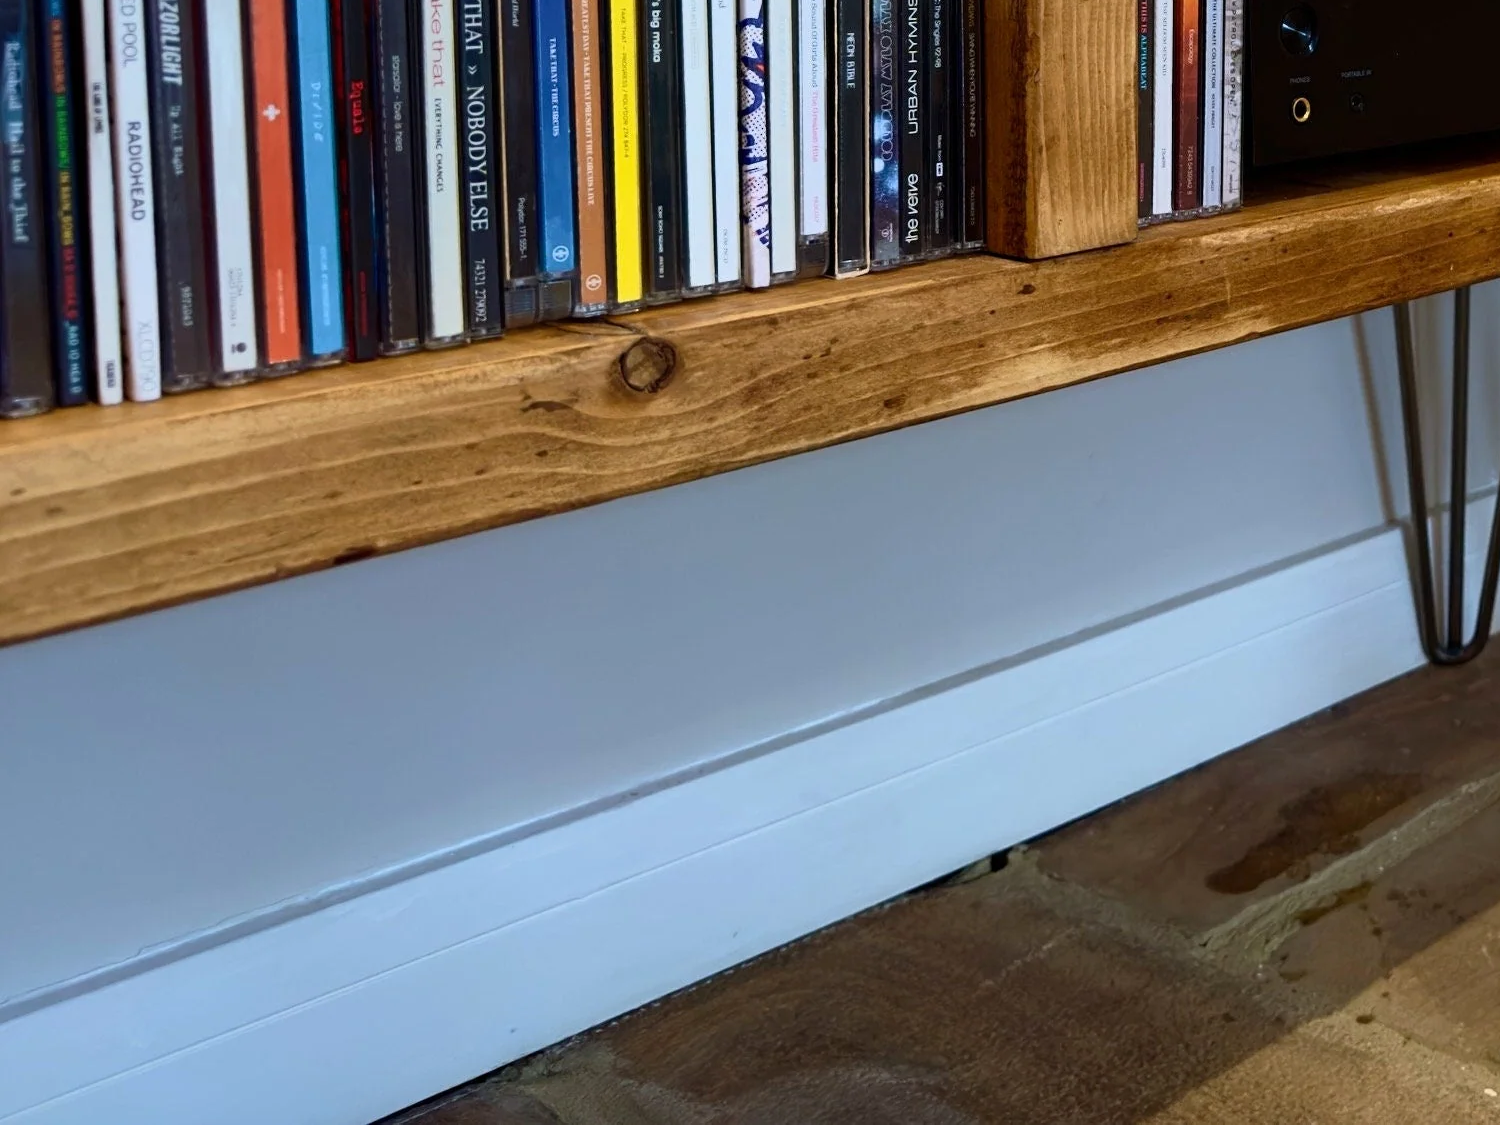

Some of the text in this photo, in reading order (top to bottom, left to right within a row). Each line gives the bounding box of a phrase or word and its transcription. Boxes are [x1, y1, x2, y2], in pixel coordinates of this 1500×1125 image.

[464, 0, 484, 54] THAT
[511, 5, 520, 27] World
[650, 10, 662, 28] big
[934, 5, 942, 19] The
[123, 23, 138, 66] POOL
[582, 35, 590, 52] DAY
[652, 32, 662, 63] moka
[846, 32, 856, 58] NEON
[933, 20, 942, 46] Singles
[432, 40, 446, 88] that
[549, 38, 558, 60] TAKE
[1140, 35, 1148, 91] ALPHABEAT
[550, 61, 559, 83] THAT
[583, 57, 591, 77] TAKE
[621, 53, 629, 88] PROGRESS
[846, 61, 856, 89] BIBLE
[350, 80, 365, 134] Equals
[394, 101, 404, 120] love
[551, 88, 559, 105] THE
[908, 69, 918, 135] URBAN
[434, 98, 443, 149] EVERYTHING
[467, 85, 487, 175] NOBODY
[552, 105, 560, 137] CIRCUS
[585, 102, 593, 138] PRESENT
[5, 41, 30, 243] Radiohead Hail to the Thief
[395, 132, 405, 152] here
[586, 139, 594, 155] THE
[127, 121, 146, 221] RADIOHEAD
[436, 153, 445, 193] CHANGES
[470, 181, 489, 232] ELSE
[908, 173, 919, 215] verve
[905, 218, 919, 243] the
[475, 258, 486, 286] 74321
[475, 289, 487, 323] 279092
